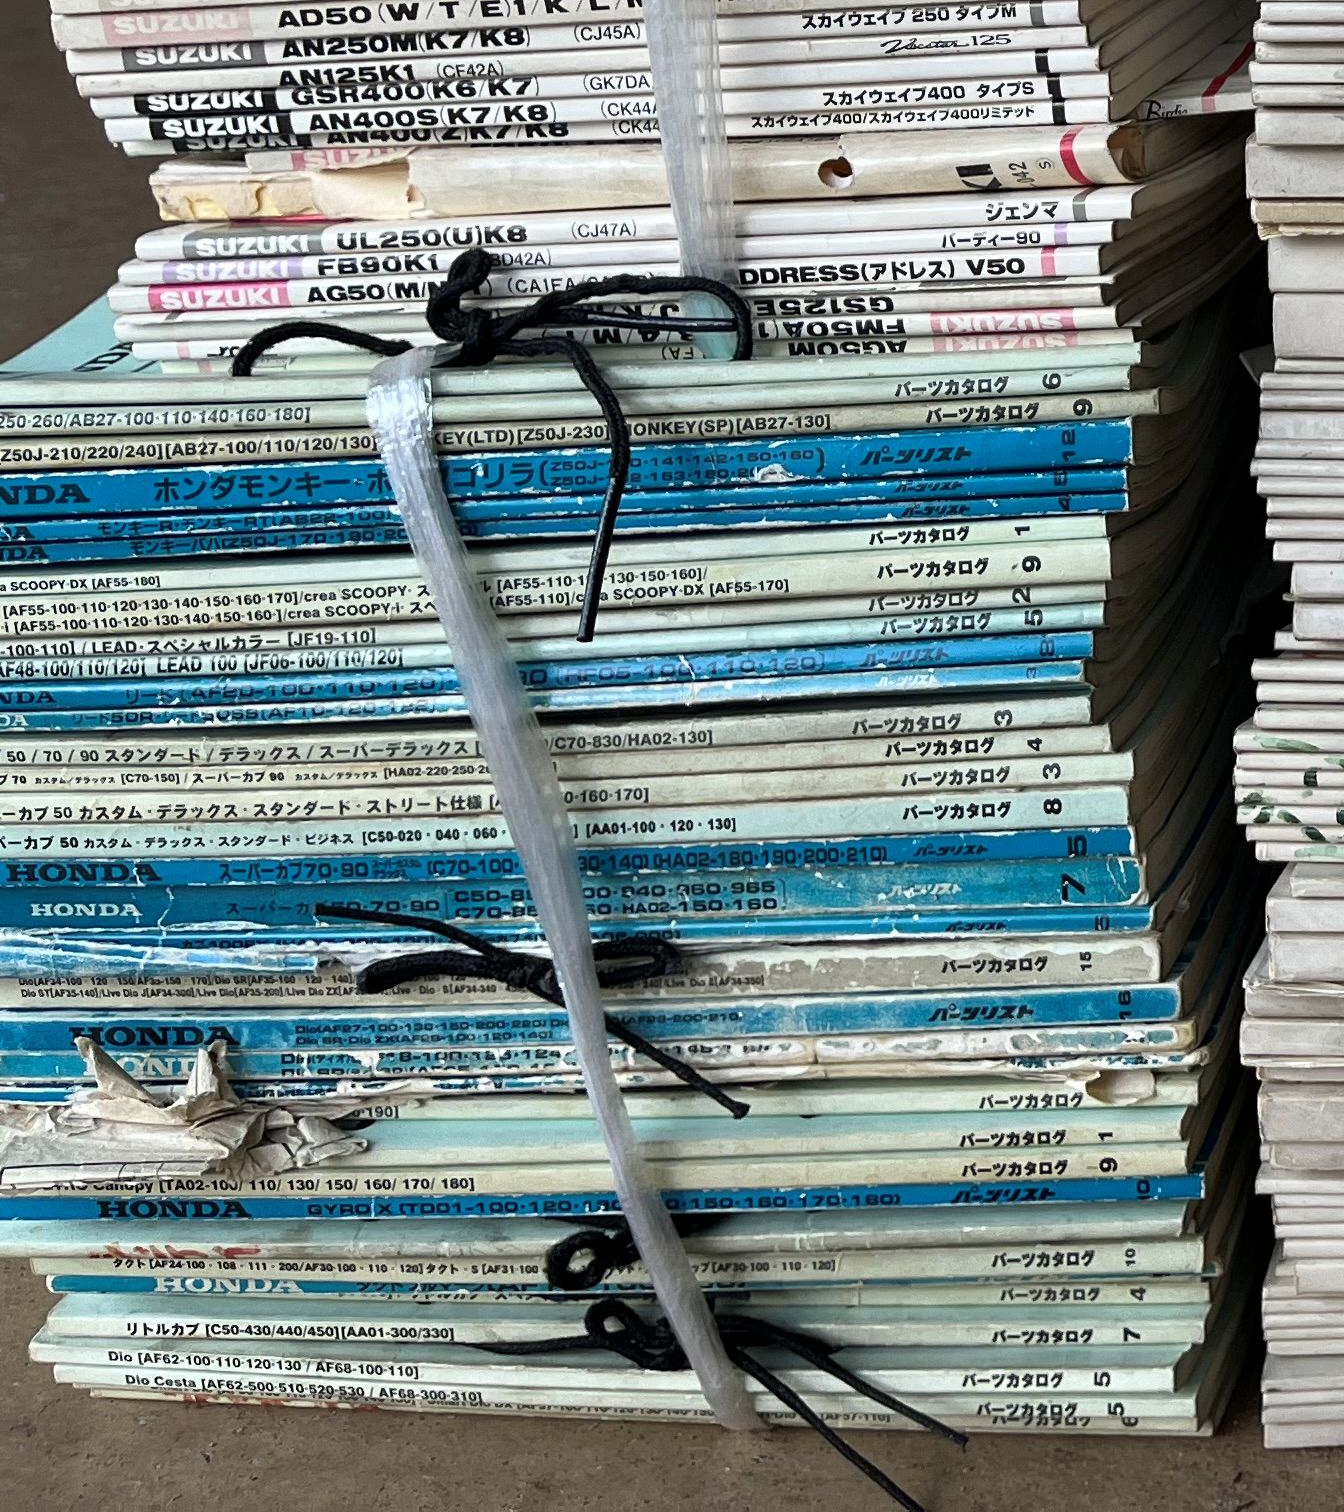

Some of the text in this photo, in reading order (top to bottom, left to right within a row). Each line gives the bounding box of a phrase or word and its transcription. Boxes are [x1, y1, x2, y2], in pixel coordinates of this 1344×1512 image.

[162, 115, 279, 141] SUZUKI
[195, 234, 308, 257] SUZUKI
[965, 258, 1026, 278] V50
[160, 286, 279, 312] SUZUKI
[31, 903, 144, 917] HONDA
[98, 1200, 252, 1219] HONDA
[108, 1351, 132, 1363] Dio
[125, 1375, 149, 1386] Dio
